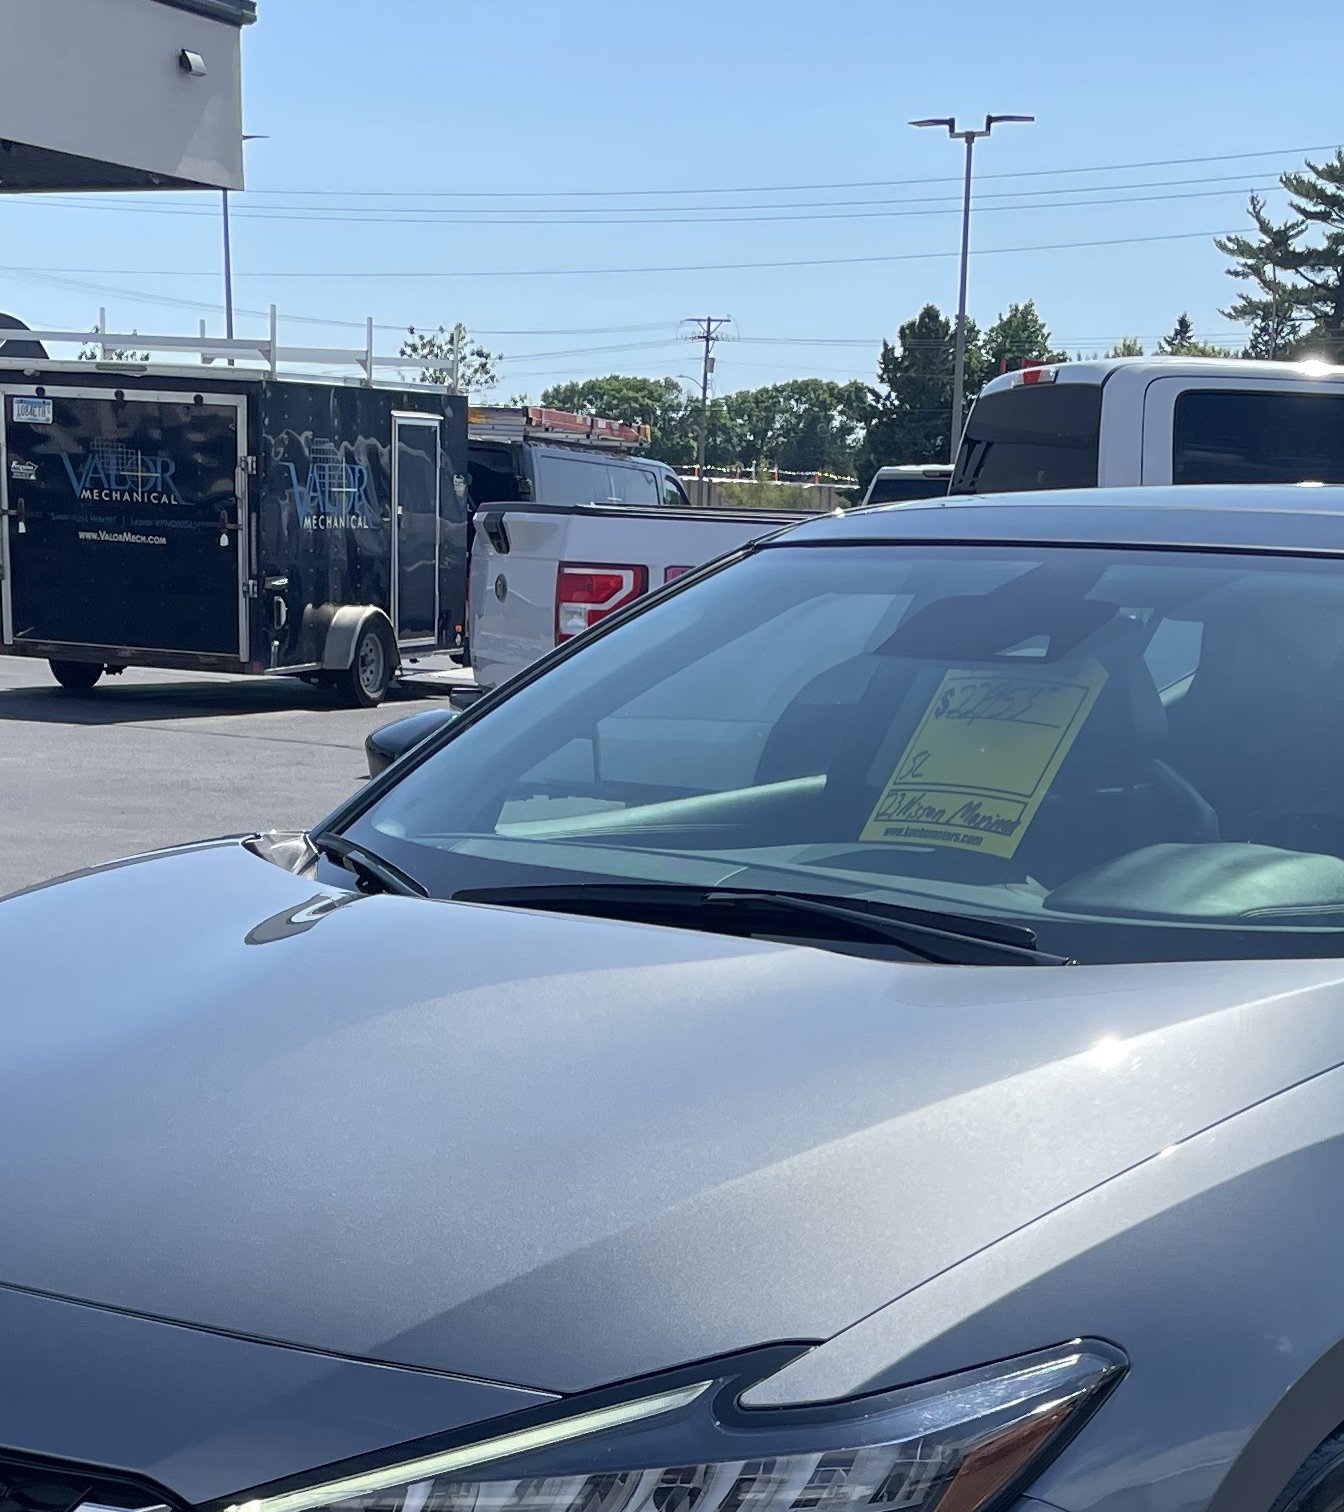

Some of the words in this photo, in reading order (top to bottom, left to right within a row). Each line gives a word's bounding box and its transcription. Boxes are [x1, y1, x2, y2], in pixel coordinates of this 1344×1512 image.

[57, 451, 195, 505] VALOR
[80, 489, 178, 504] MECHANICAL
[277, 462, 382, 530] VALOR
[303, 514, 368, 529] MECHANICAL
